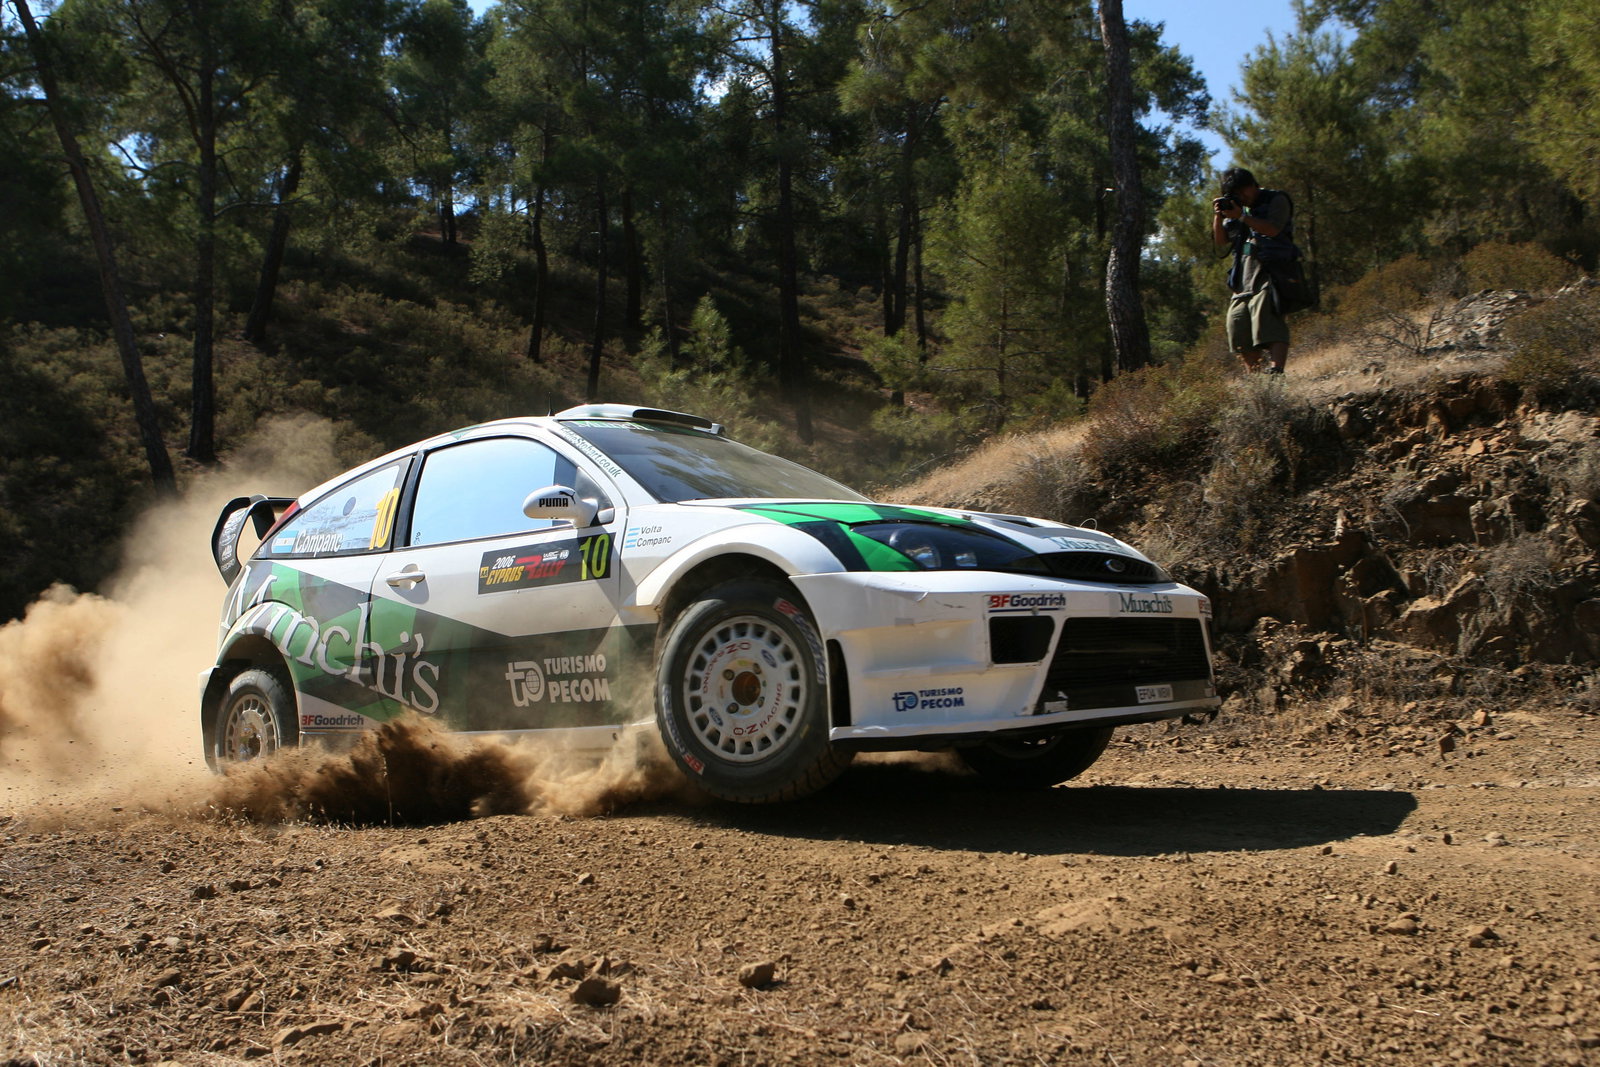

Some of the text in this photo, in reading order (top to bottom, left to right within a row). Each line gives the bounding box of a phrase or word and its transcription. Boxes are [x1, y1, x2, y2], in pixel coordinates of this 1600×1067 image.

[538, 497, 569, 508] PUMA
[368, 487, 400, 550] 10
[641, 526, 663, 535] Volta
[295, 529, 343, 557] Companc
[636, 536, 672, 547] Companc
[492, 555, 516, 570] 2006
[579, 533, 610, 580] 10
[485, 565, 525, 585] CYPRUS
[989, 593, 1066, 609] BFGoodrich
[544, 654, 607, 675] TURISMO
[548, 678, 612, 703] PECOM
[919, 687, 963, 698] TURISMO
[921, 697, 965, 710] PECOM
